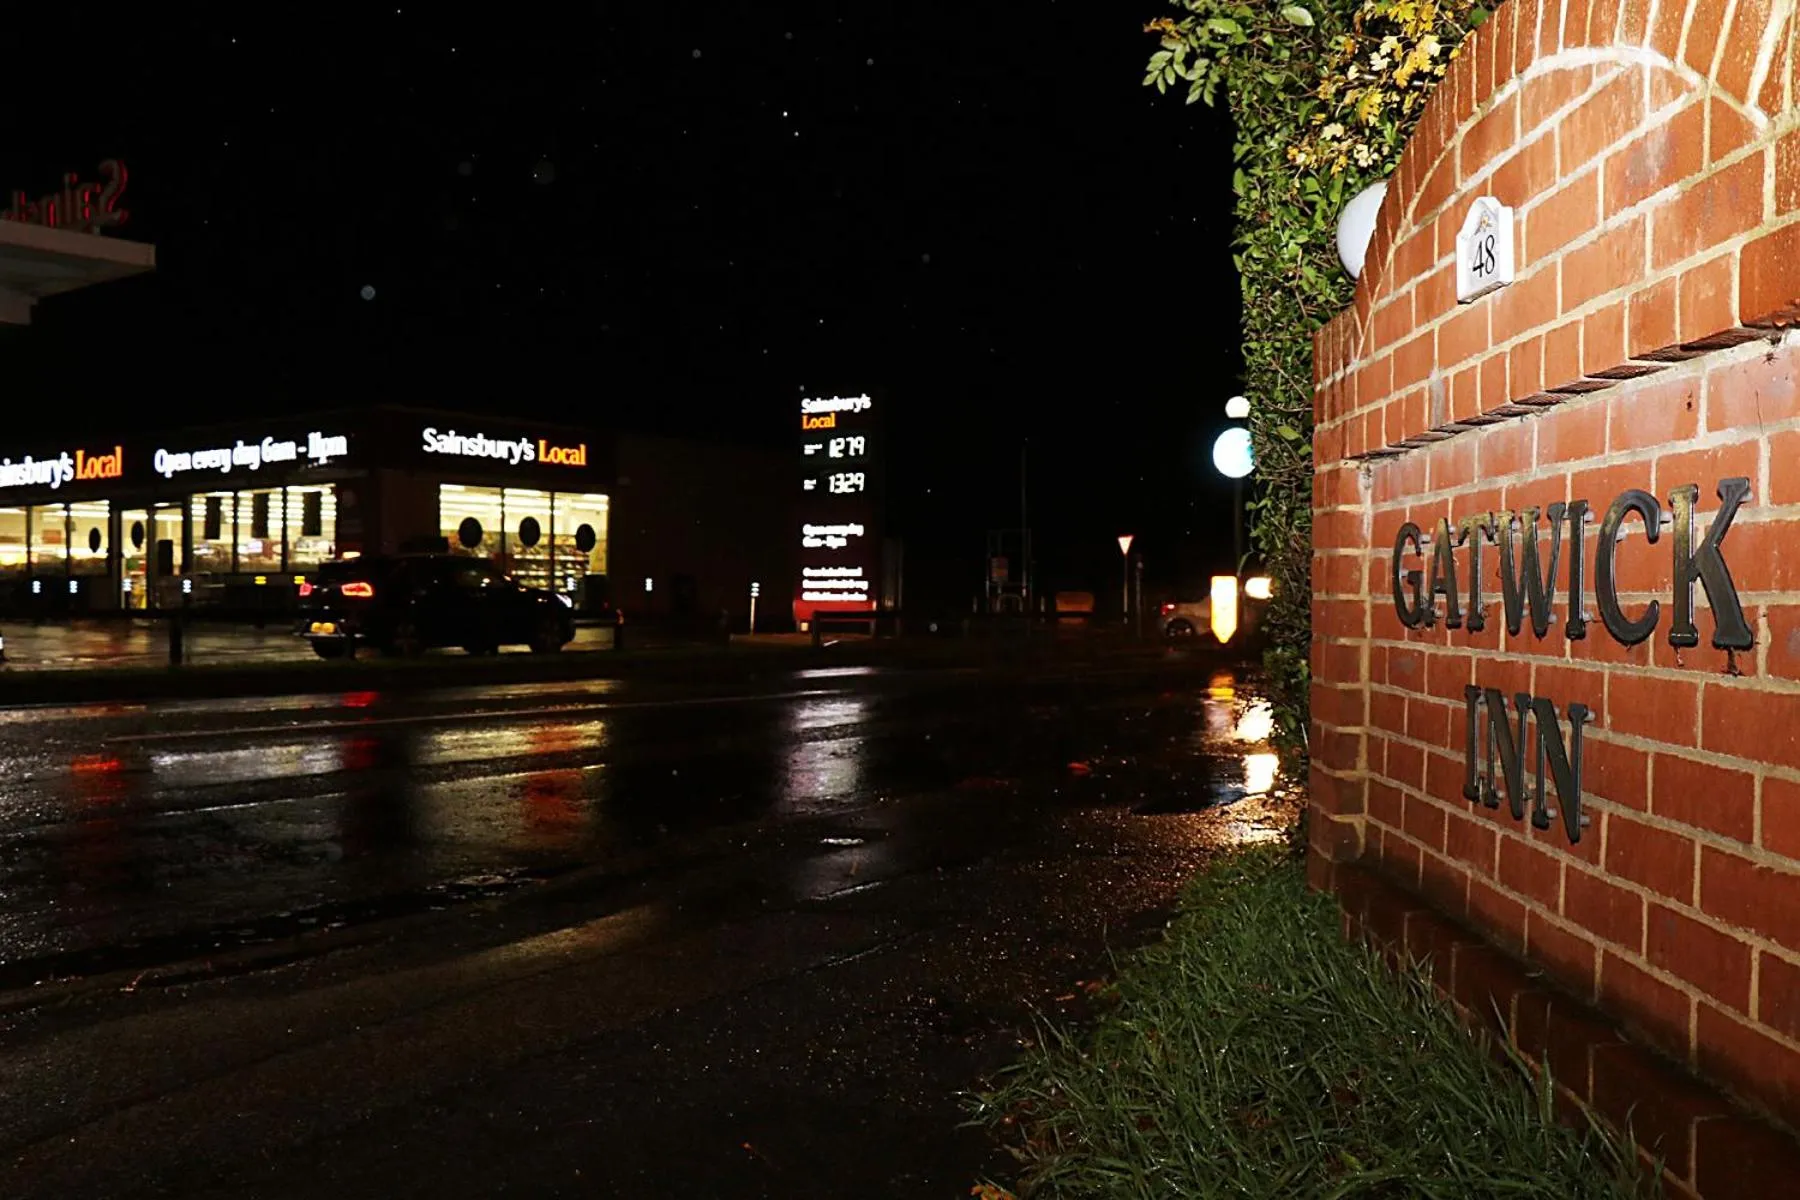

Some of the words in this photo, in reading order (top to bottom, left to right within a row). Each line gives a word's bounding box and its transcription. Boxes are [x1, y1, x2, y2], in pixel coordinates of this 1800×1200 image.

[1472, 234, 1495, 278] 48
[802, 412, 836, 430] Local
[75, 446, 122, 480] Local
[154, 449, 191, 478] Open
[233, 440, 260, 470] day
[422, 427, 535, 465] Sainsbury's
[538, 439, 587, 466] Local
[1393, 477, 1753, 650] GATWICK
[1464, 684, 1588, 843] INN
